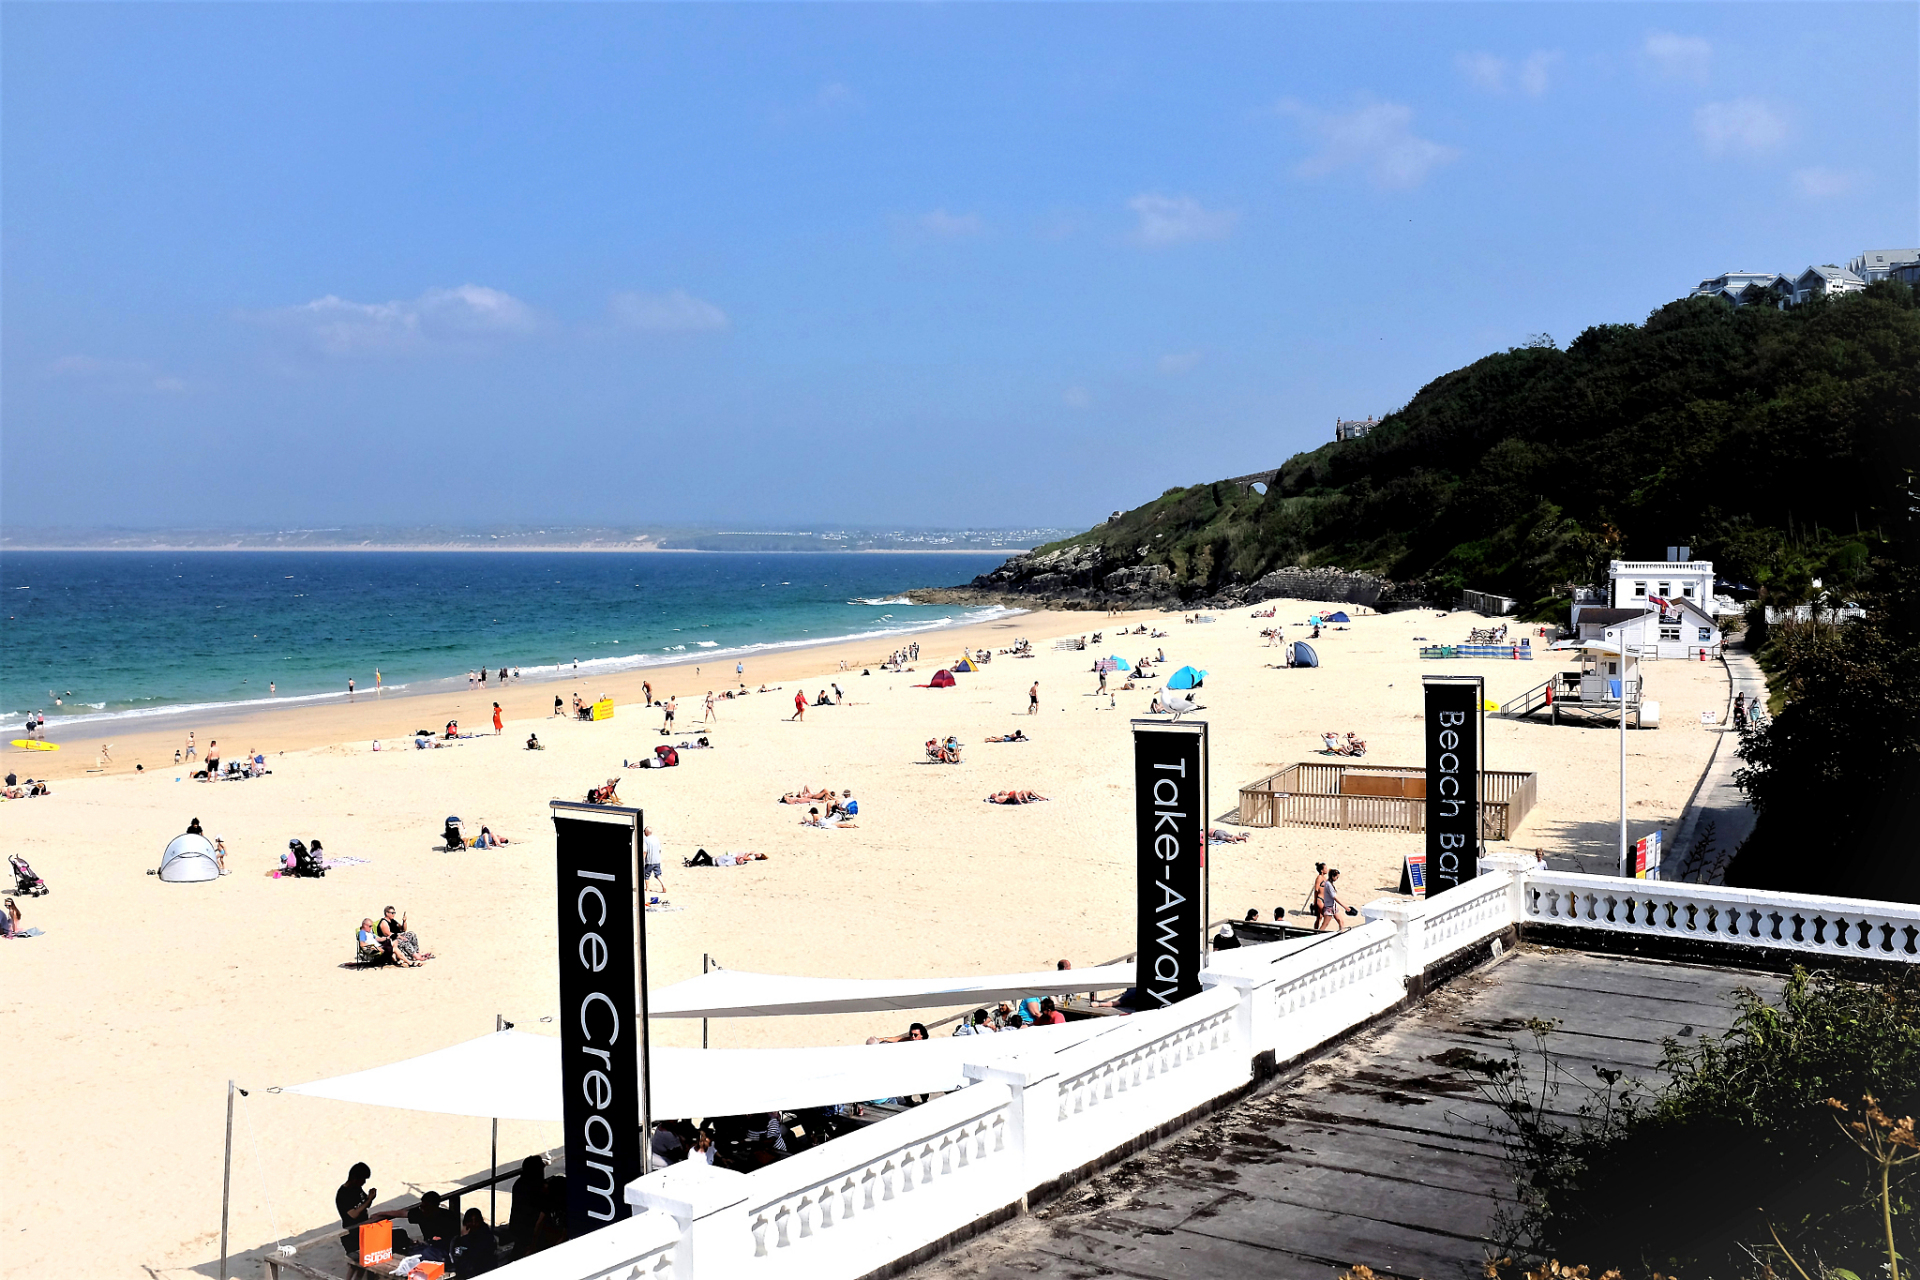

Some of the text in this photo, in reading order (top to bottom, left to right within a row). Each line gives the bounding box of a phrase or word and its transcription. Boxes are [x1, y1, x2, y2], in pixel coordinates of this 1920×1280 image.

[1147, 758, 1187, 1009] Take-Away
[1440, 711, 1466, 885] Beach Bar
[577, 870, 619, 1222] Ice Cream
